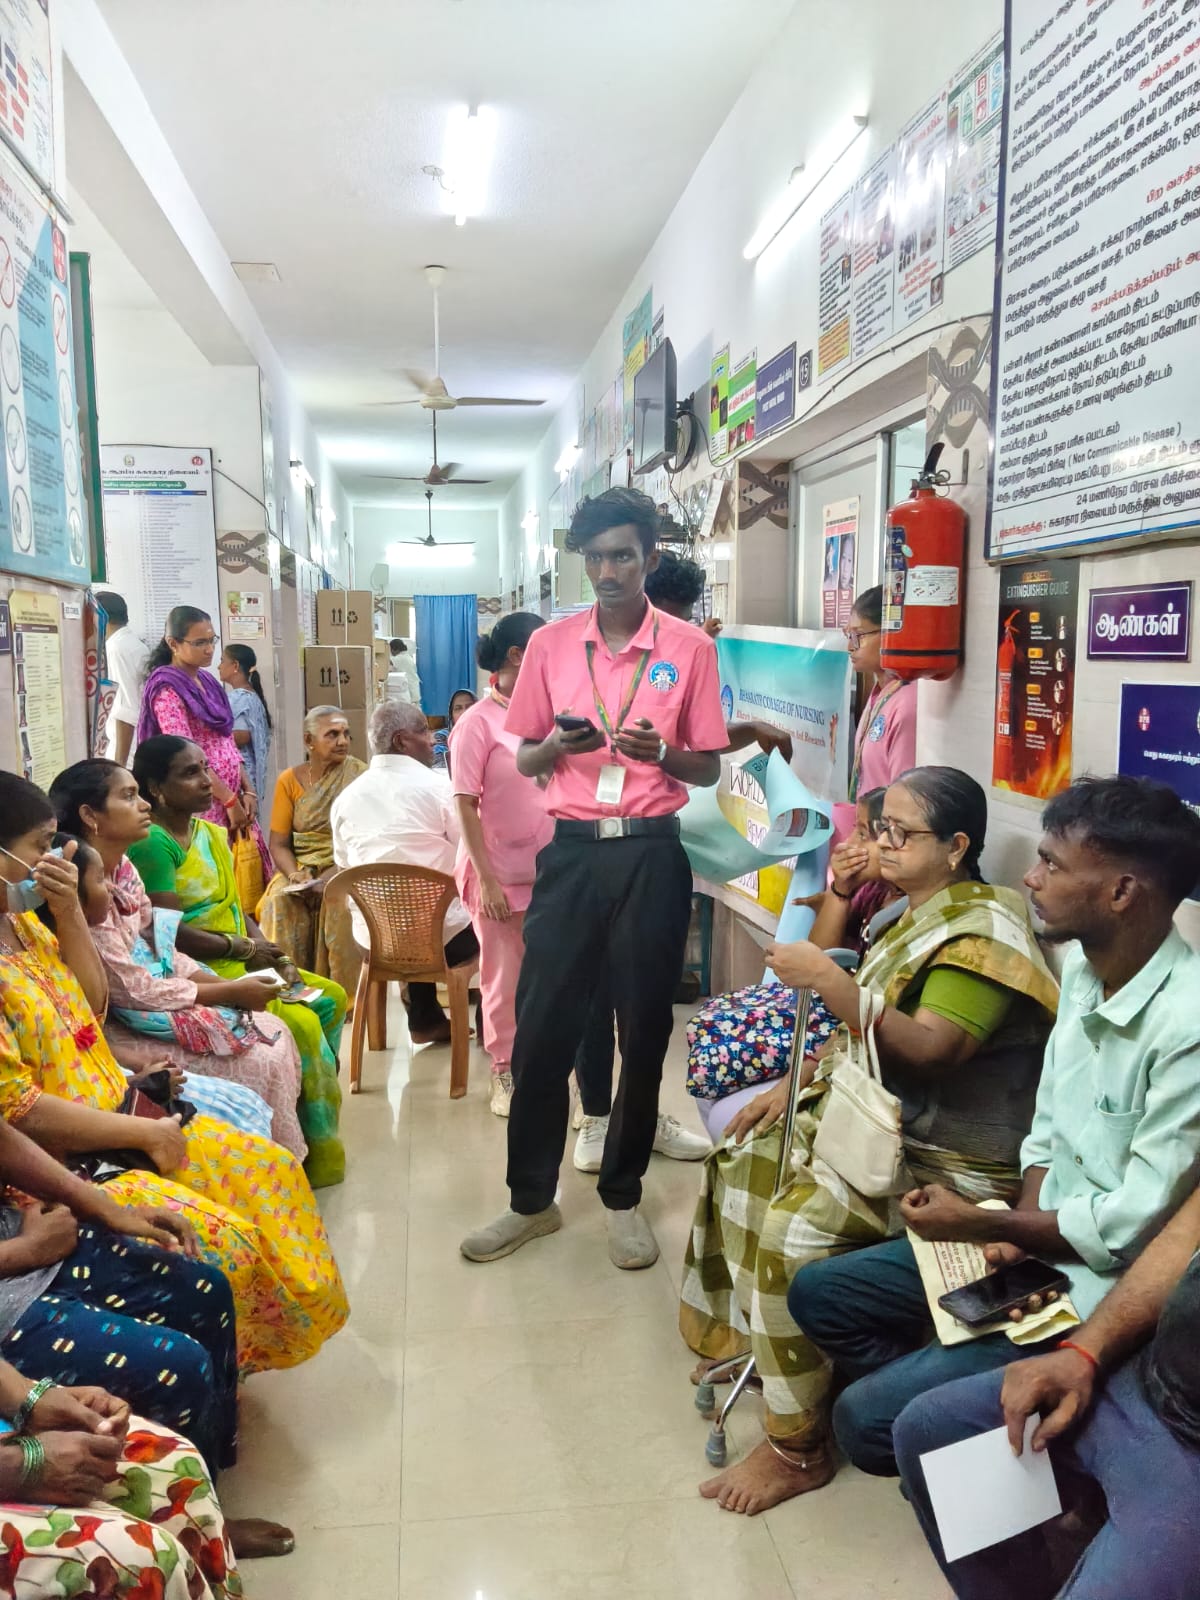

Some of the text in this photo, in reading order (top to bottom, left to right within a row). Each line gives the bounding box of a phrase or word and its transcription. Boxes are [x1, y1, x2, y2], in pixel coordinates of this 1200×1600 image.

[1125, 238, 1141, 256] 108
[1142, 426, 1175, 443] Disease
[1076, 493, 1088, 506] 24
[1007, 581, 1070, 599] EXTINGUISHER GUIDE
[1096, 602, 1181, 643] ஆண்கள்
[762, 695, 787, 713] COLLEGE
[787, 702, 796, 717] OF
[795, 705, 825, 726] NURSING
